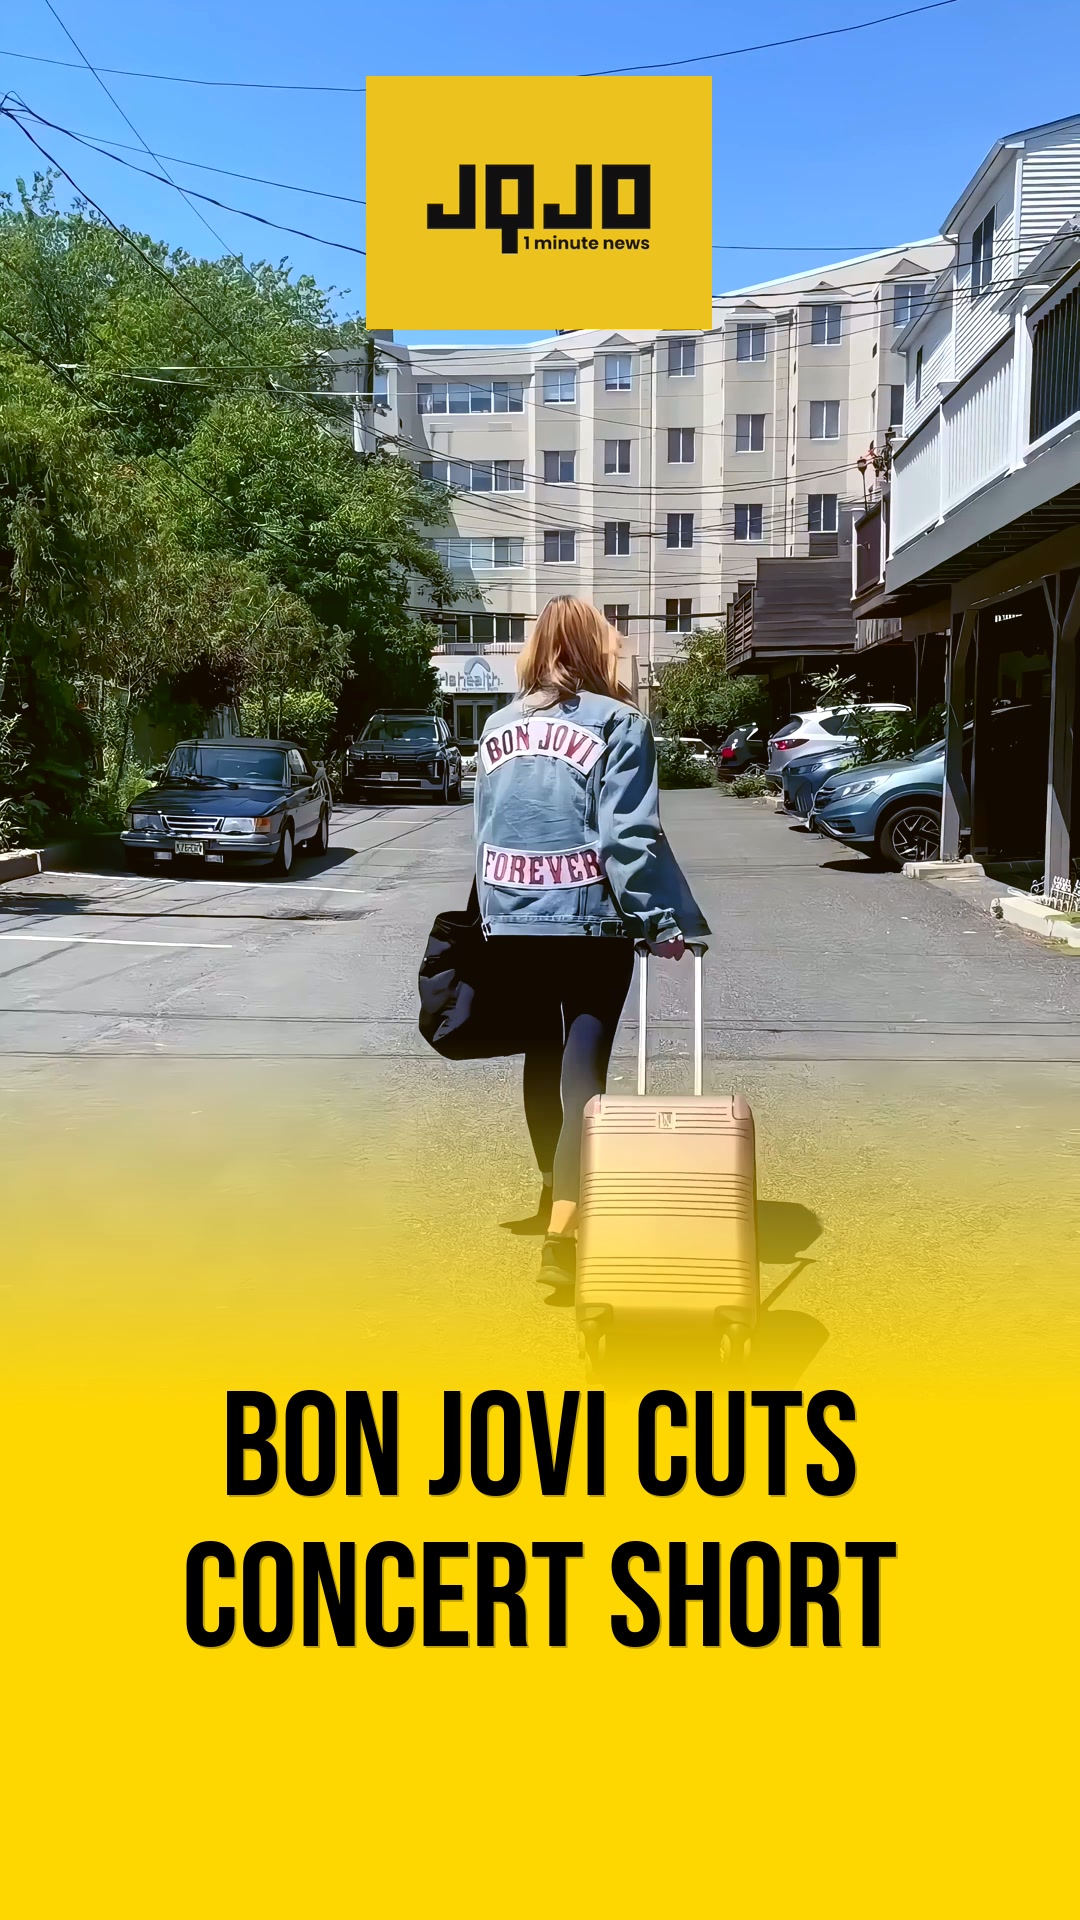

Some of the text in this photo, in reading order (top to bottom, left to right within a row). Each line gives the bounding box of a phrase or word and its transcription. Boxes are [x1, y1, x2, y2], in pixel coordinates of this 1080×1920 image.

[485, 722, 599, 767] BON JOVI
[484, 848, 604, 885] FOREVER
